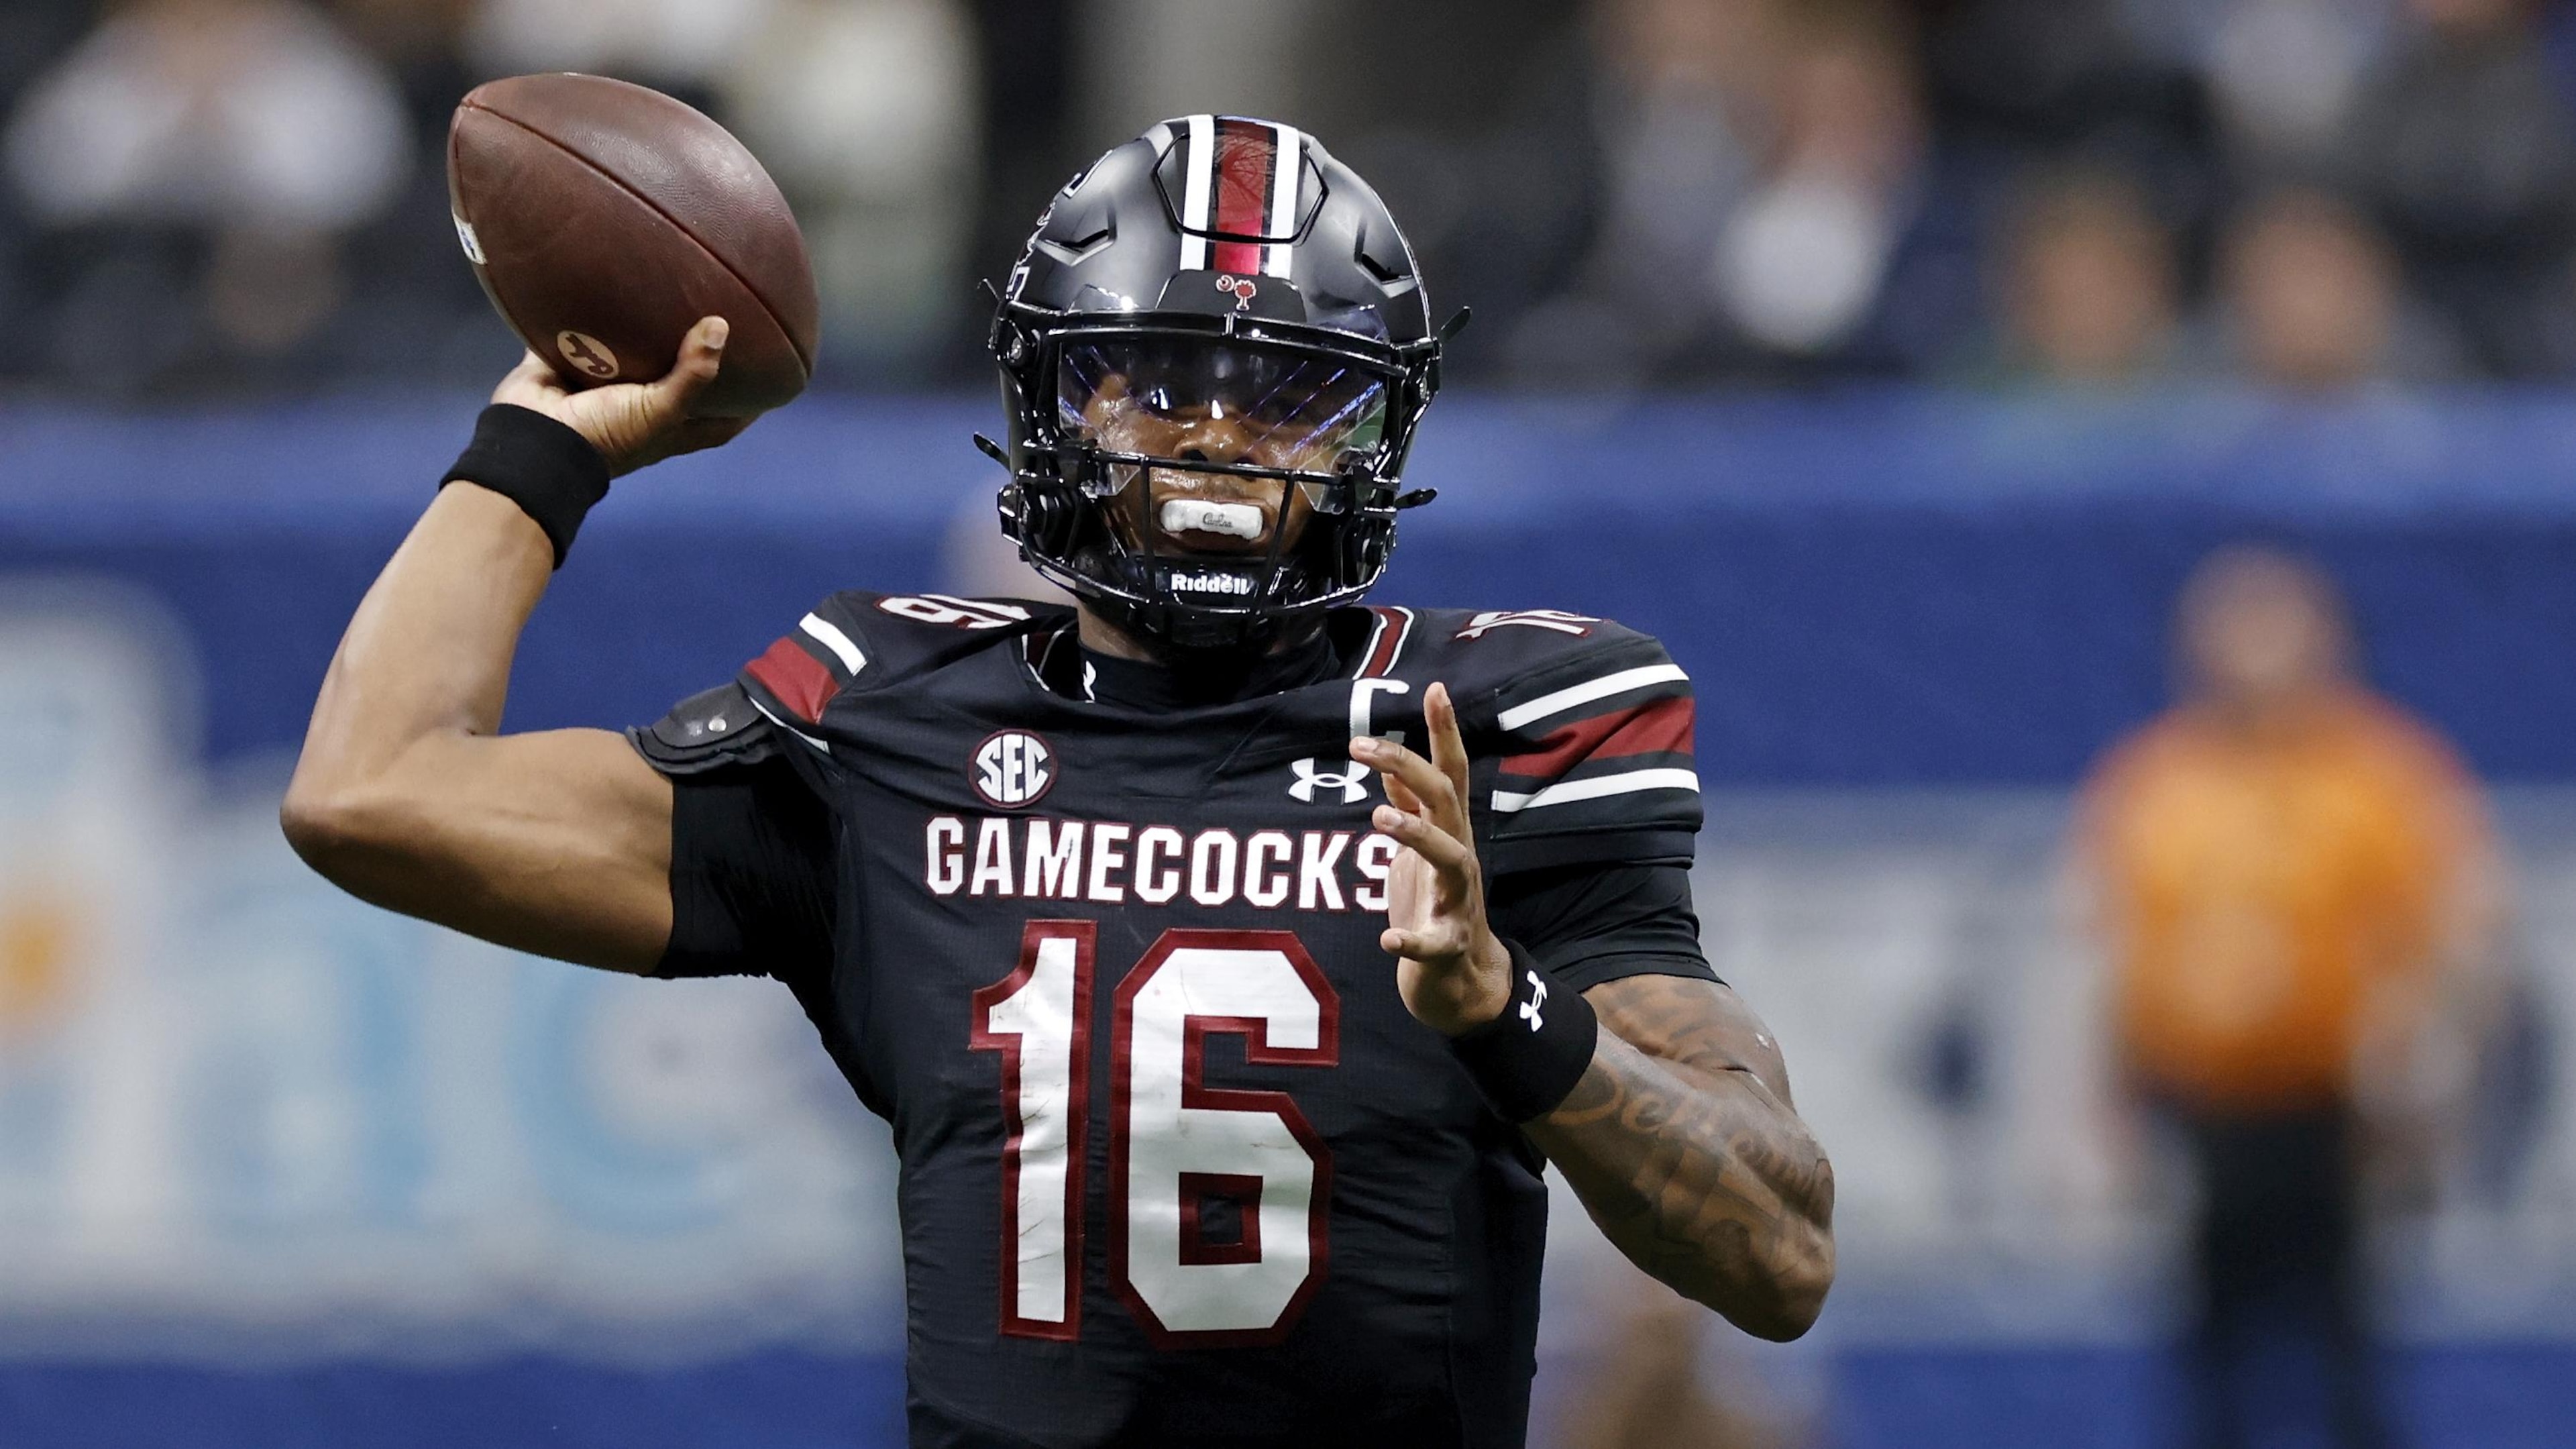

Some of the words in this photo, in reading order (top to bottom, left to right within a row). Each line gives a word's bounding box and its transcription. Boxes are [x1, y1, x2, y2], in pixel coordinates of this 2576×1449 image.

[1171, 574, 1248, 595] Riddell
[976, 734, 1049, 802] SEC
[925, 814, 1399, 912] GAMECOCKS
[968, 920, 1340, 1348] 16
